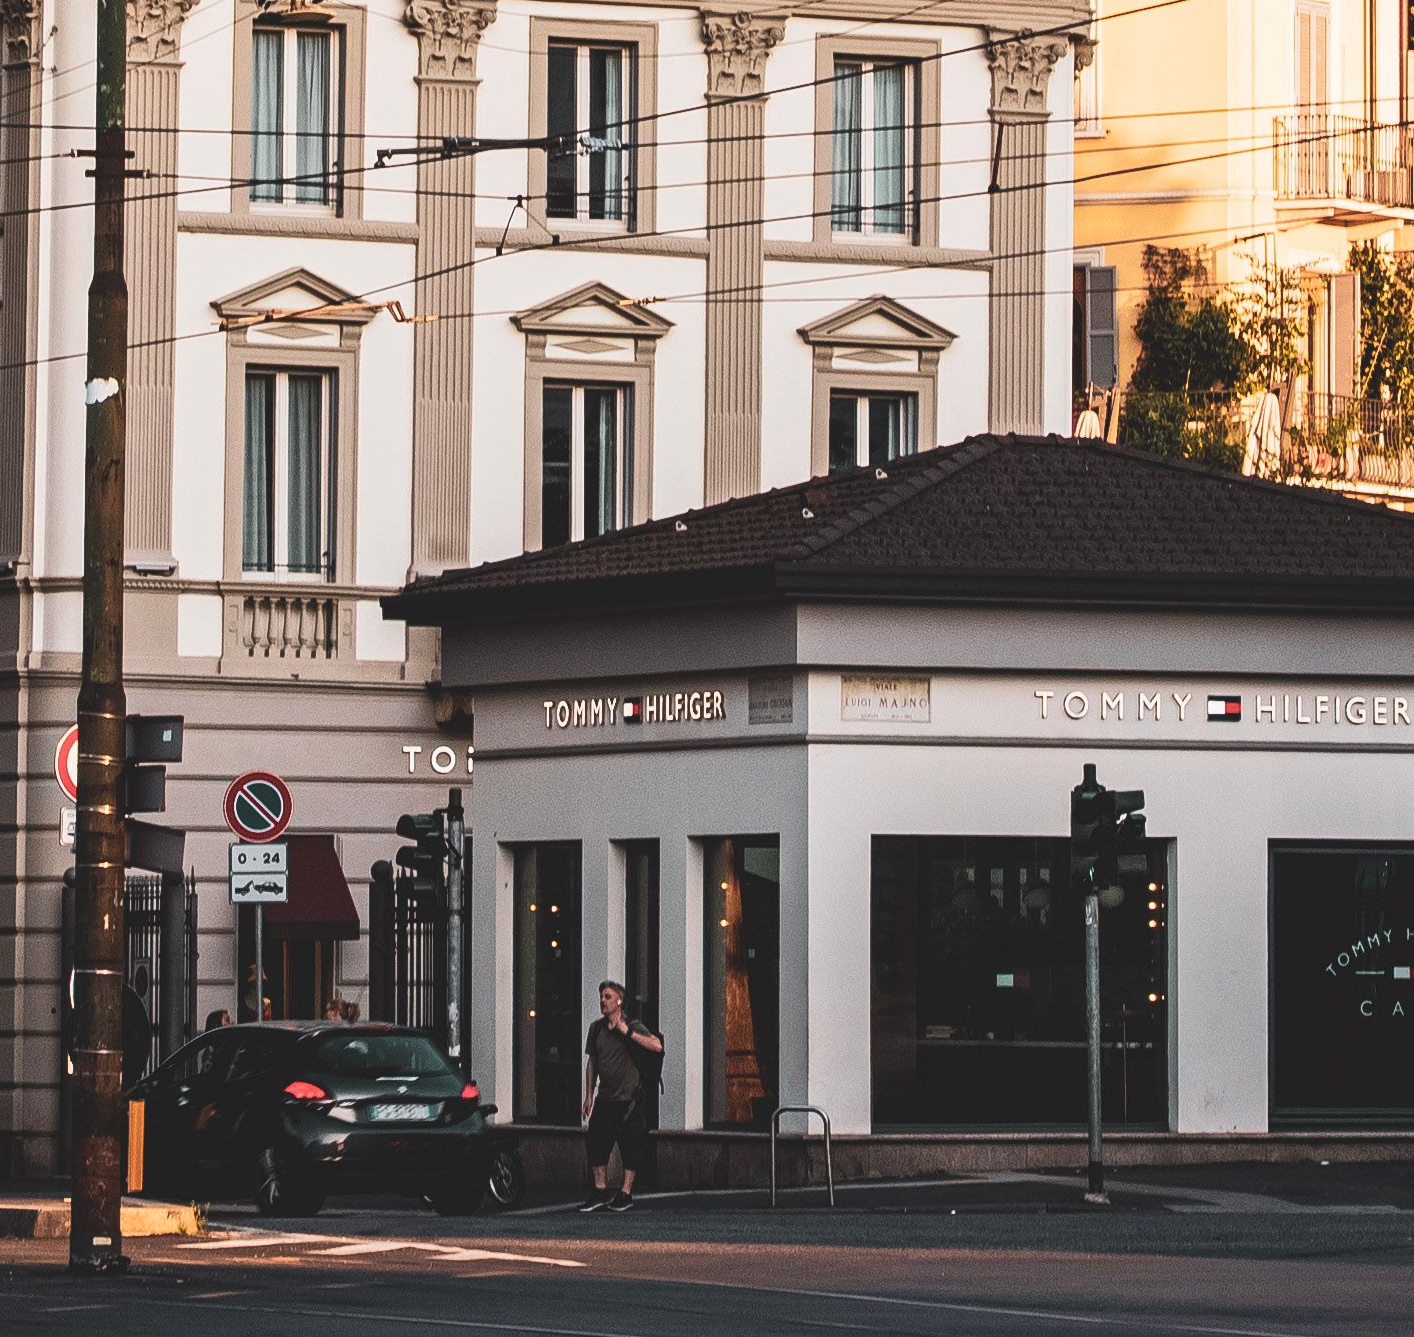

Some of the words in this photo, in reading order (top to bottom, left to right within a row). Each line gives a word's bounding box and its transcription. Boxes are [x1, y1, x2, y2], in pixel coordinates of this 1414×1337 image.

[542, 697, 617, 729] TOMMY
[646, 690, 724, 722] HILFIGER
[1034, 690, 1192, 721] TOMMY
[1255, 694, 1412, 726] HILFIGER
[402, 745, 474, 774] TO
[262, 852, 280, 864] 24
[1325, 928, 1392, 977] TOMMY
